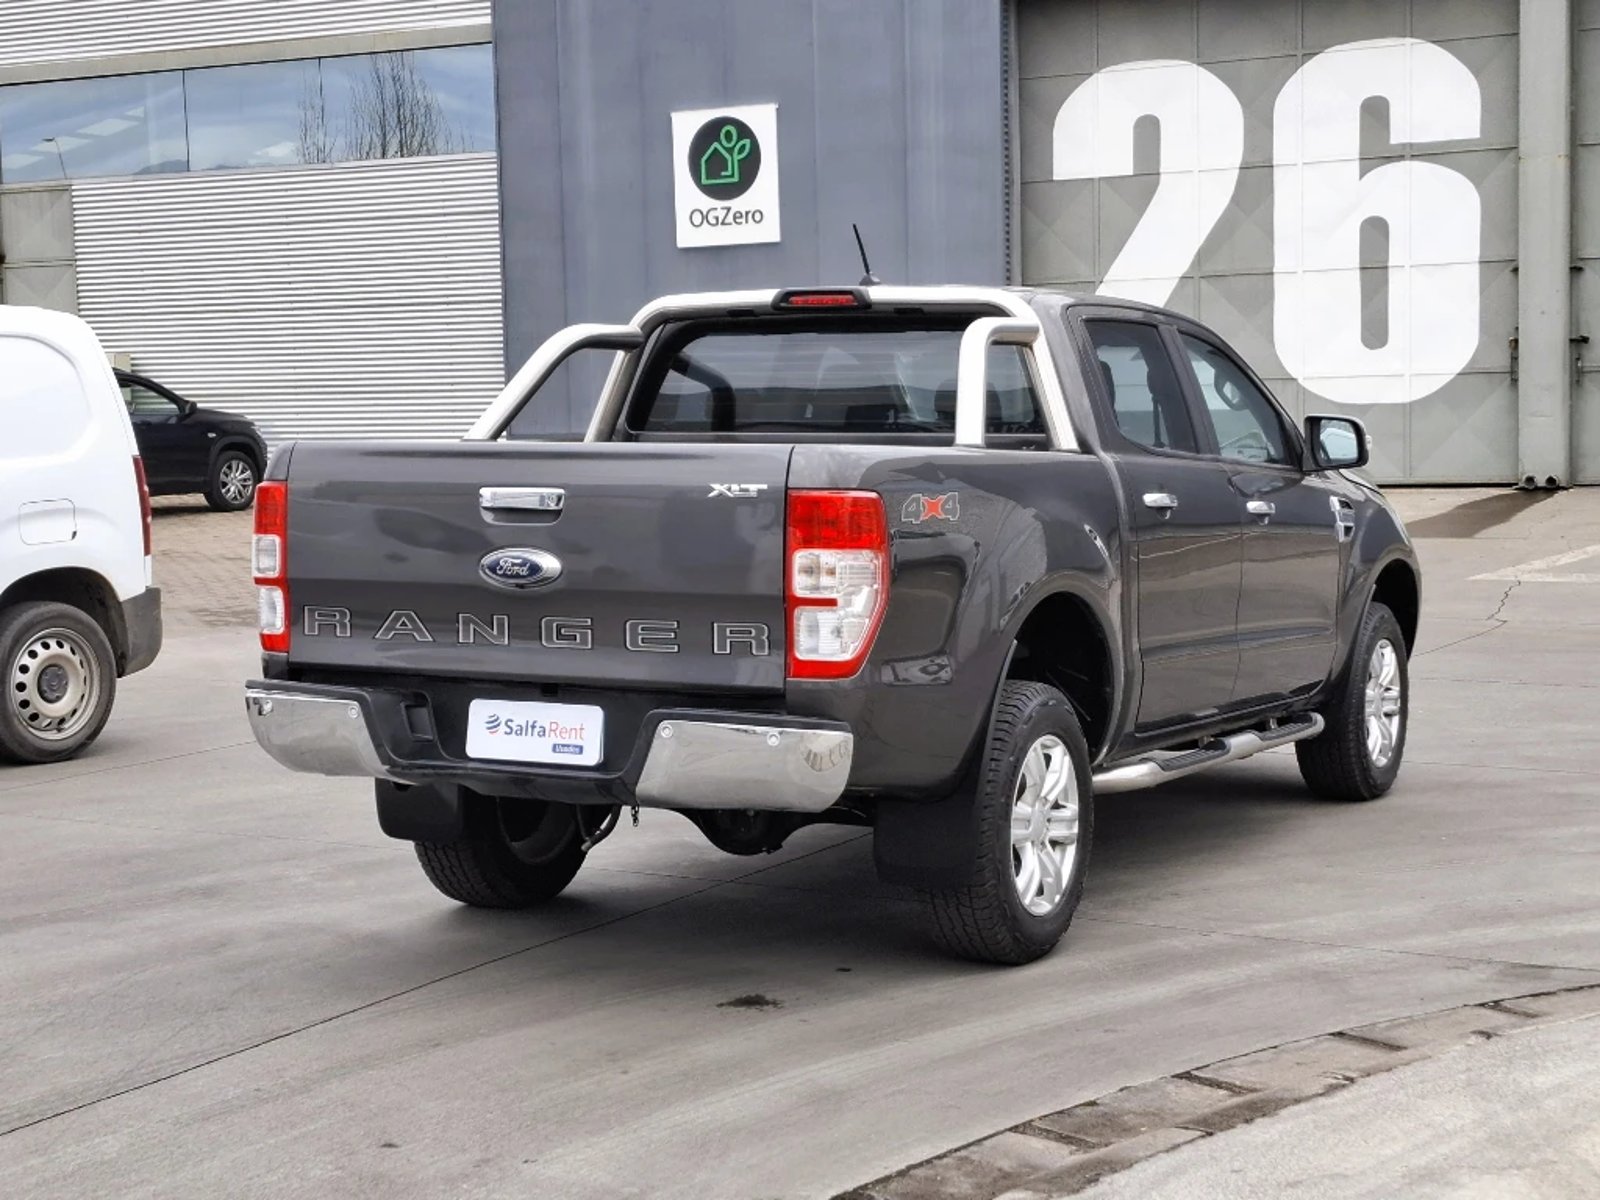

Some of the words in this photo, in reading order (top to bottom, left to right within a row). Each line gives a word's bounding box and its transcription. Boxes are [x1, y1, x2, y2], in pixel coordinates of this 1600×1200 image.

[689, 206, 764, 228] OGZero
[1053, 37, 1481, 404] 26
[707, 483, 768, 498] XLT
[496, 557, 530, 576] Ford
[303, 605, 770, 656] RANGER
[504, 718, 585, 741] SalfaRent
